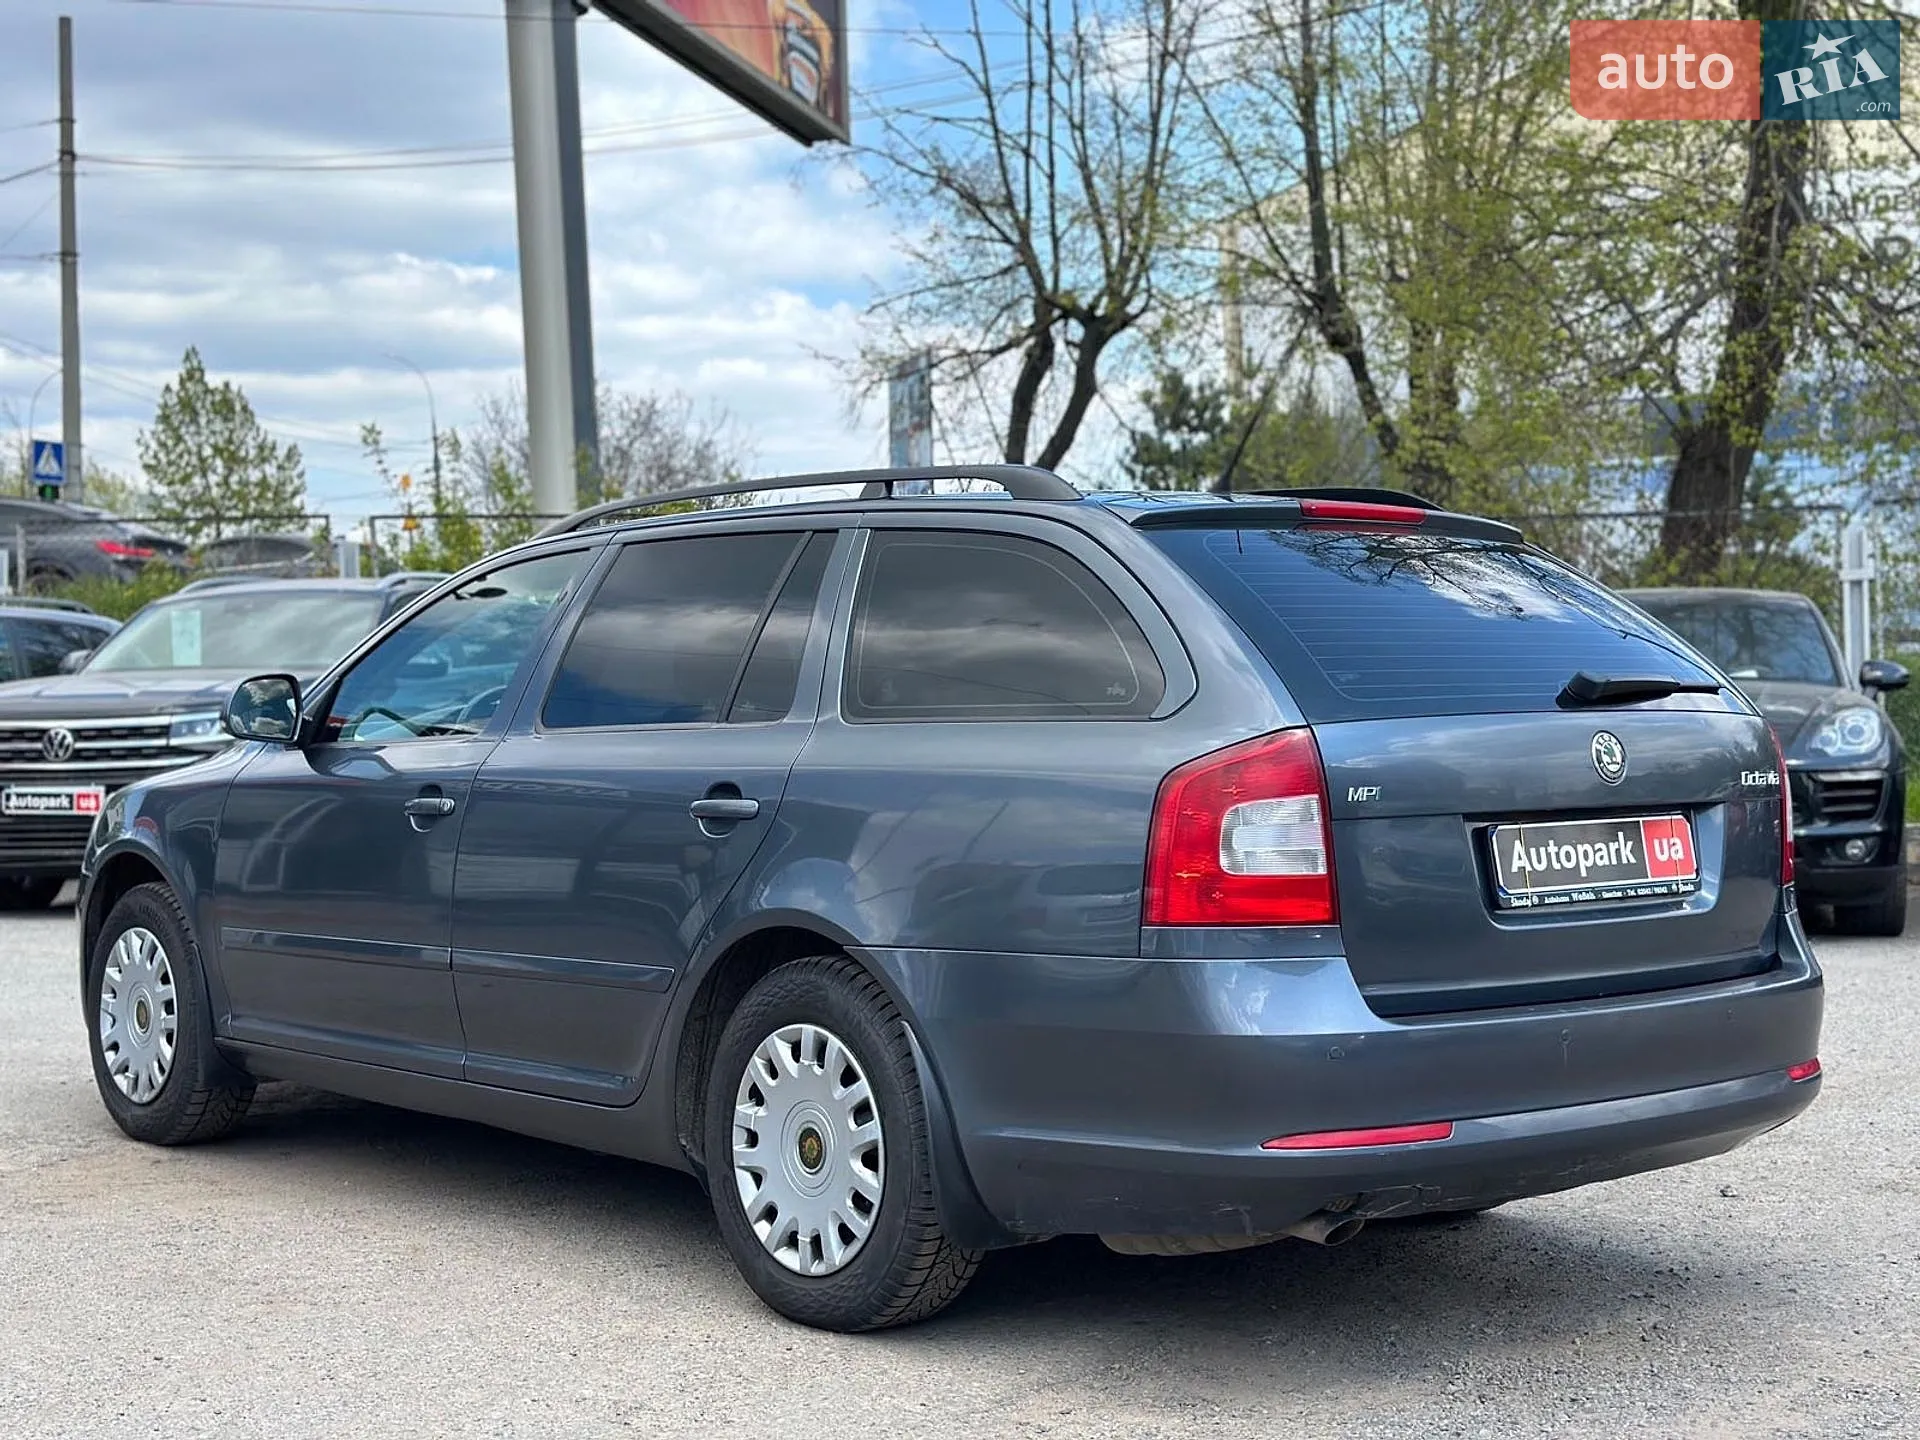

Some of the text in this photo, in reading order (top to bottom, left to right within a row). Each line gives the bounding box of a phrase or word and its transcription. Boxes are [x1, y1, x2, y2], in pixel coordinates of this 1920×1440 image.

[8, 793, 71, 809] Autopark
[1510, 832, 1685, 878] Autopark ua
